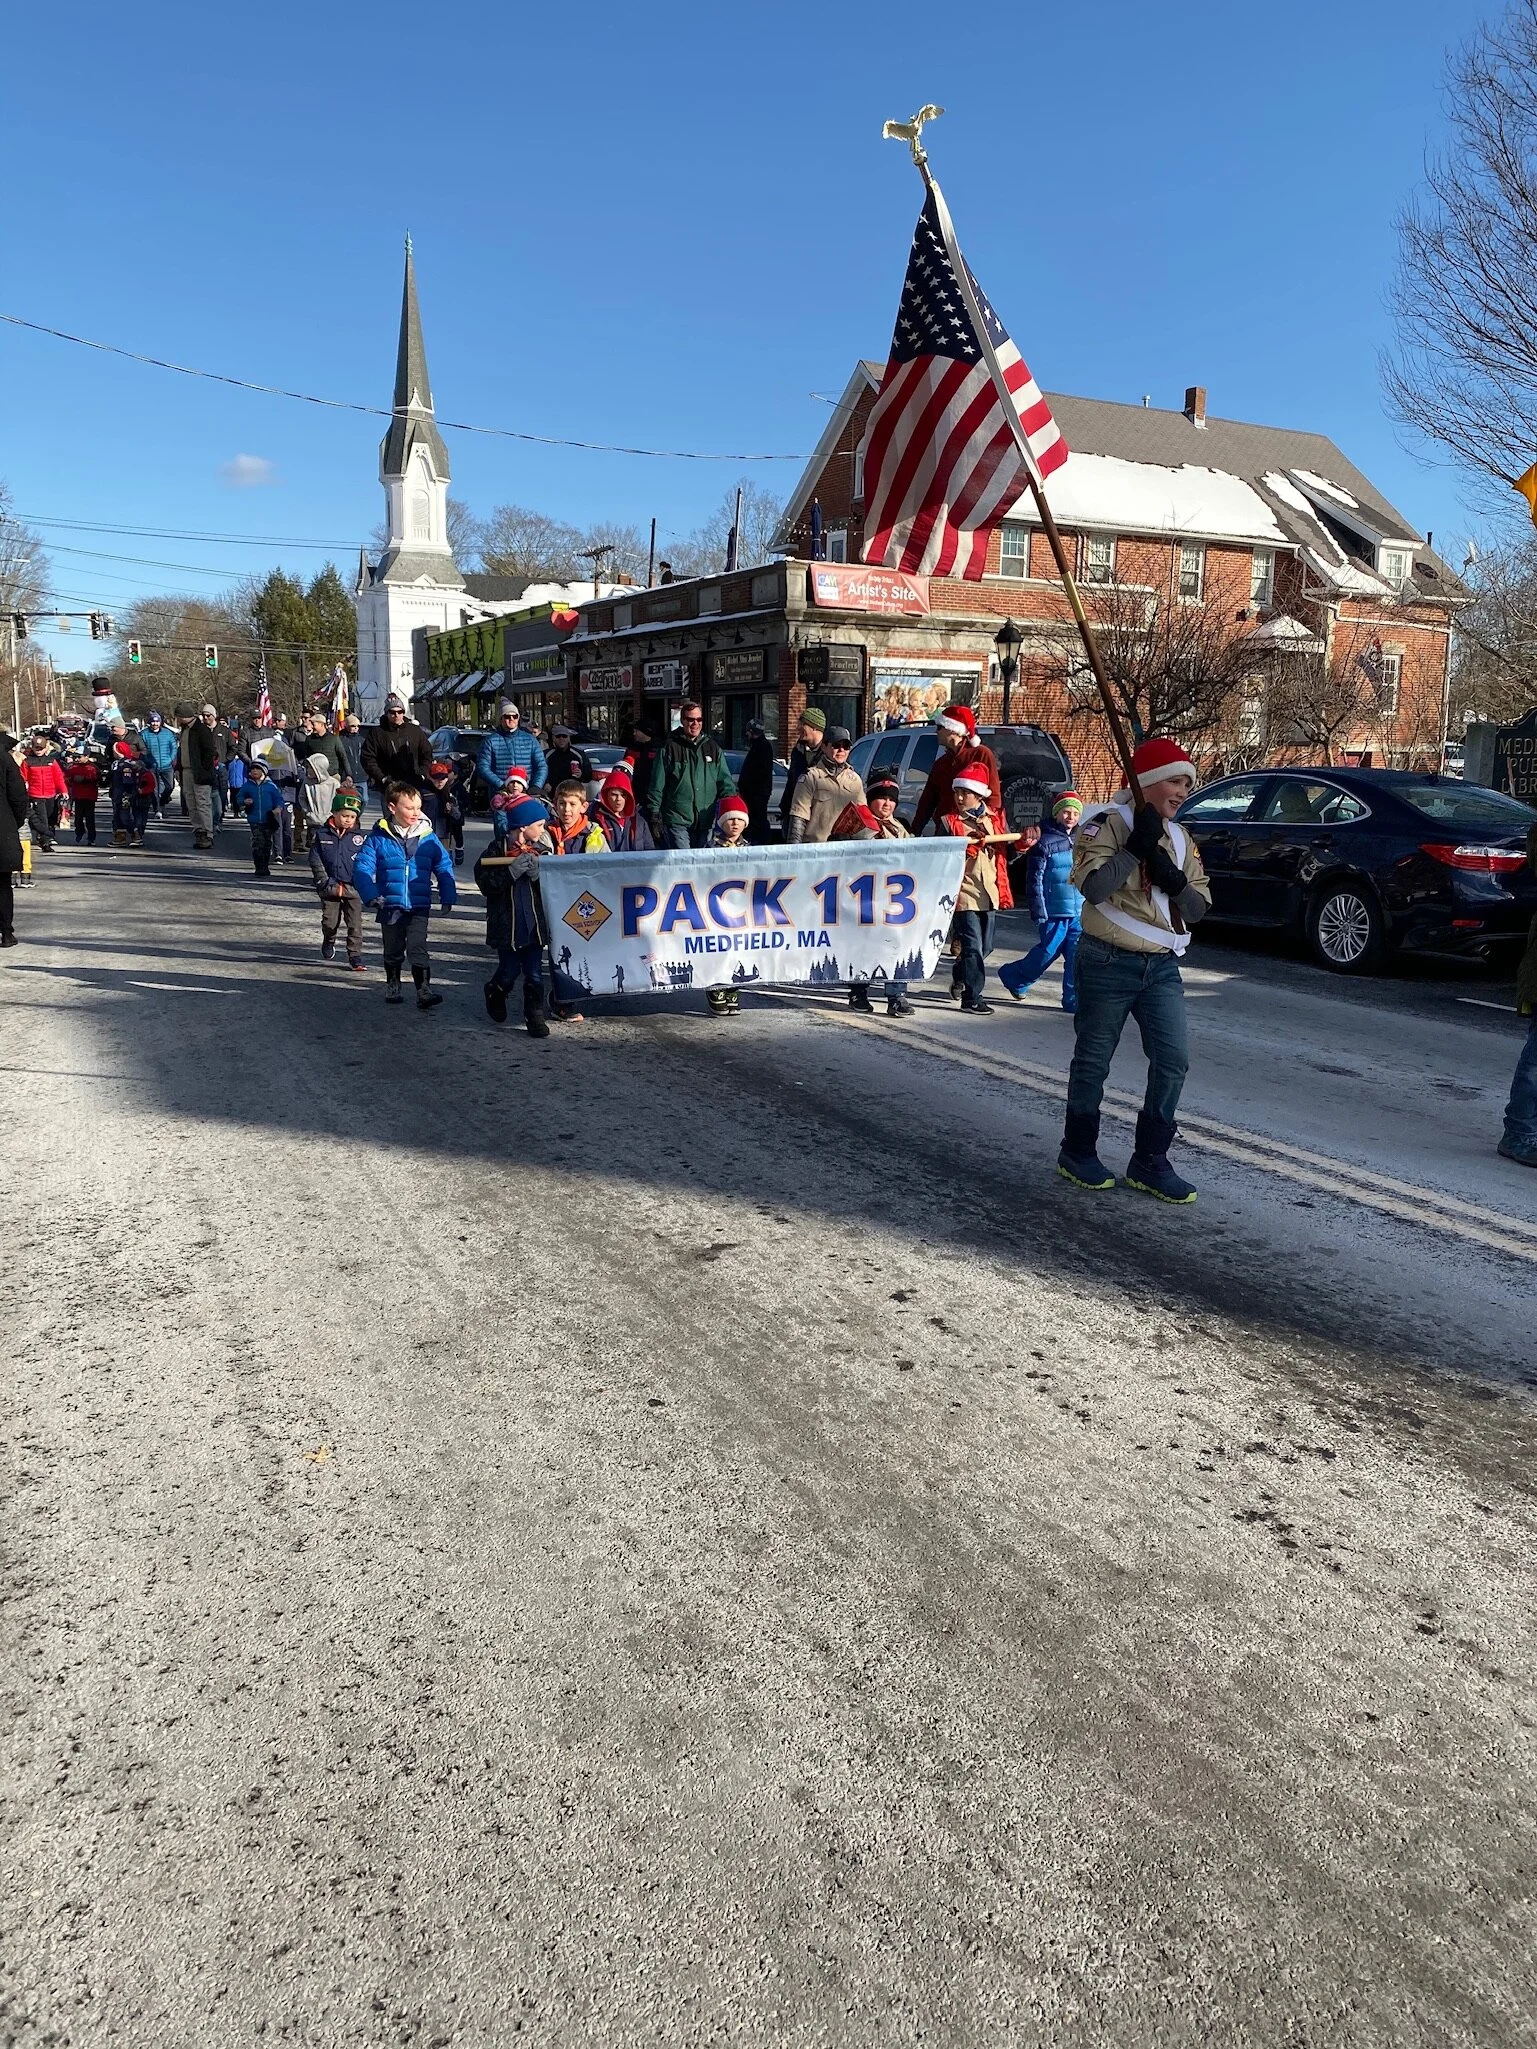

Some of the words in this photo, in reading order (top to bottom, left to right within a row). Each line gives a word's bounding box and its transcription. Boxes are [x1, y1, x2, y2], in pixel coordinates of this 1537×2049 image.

[848, 581, 888, 598] Artist's
[891, 584, 916, 601] Site
[1498, 737, 1537, 755] MED
[1018, 804, 1038, 814] Jeep
[621, 876, 796, 939] PACK
[810, 871, 918, 928] 113
[684, 930, 790, 955] MEDFIELD,
[797, 930, 831, 949] MA
